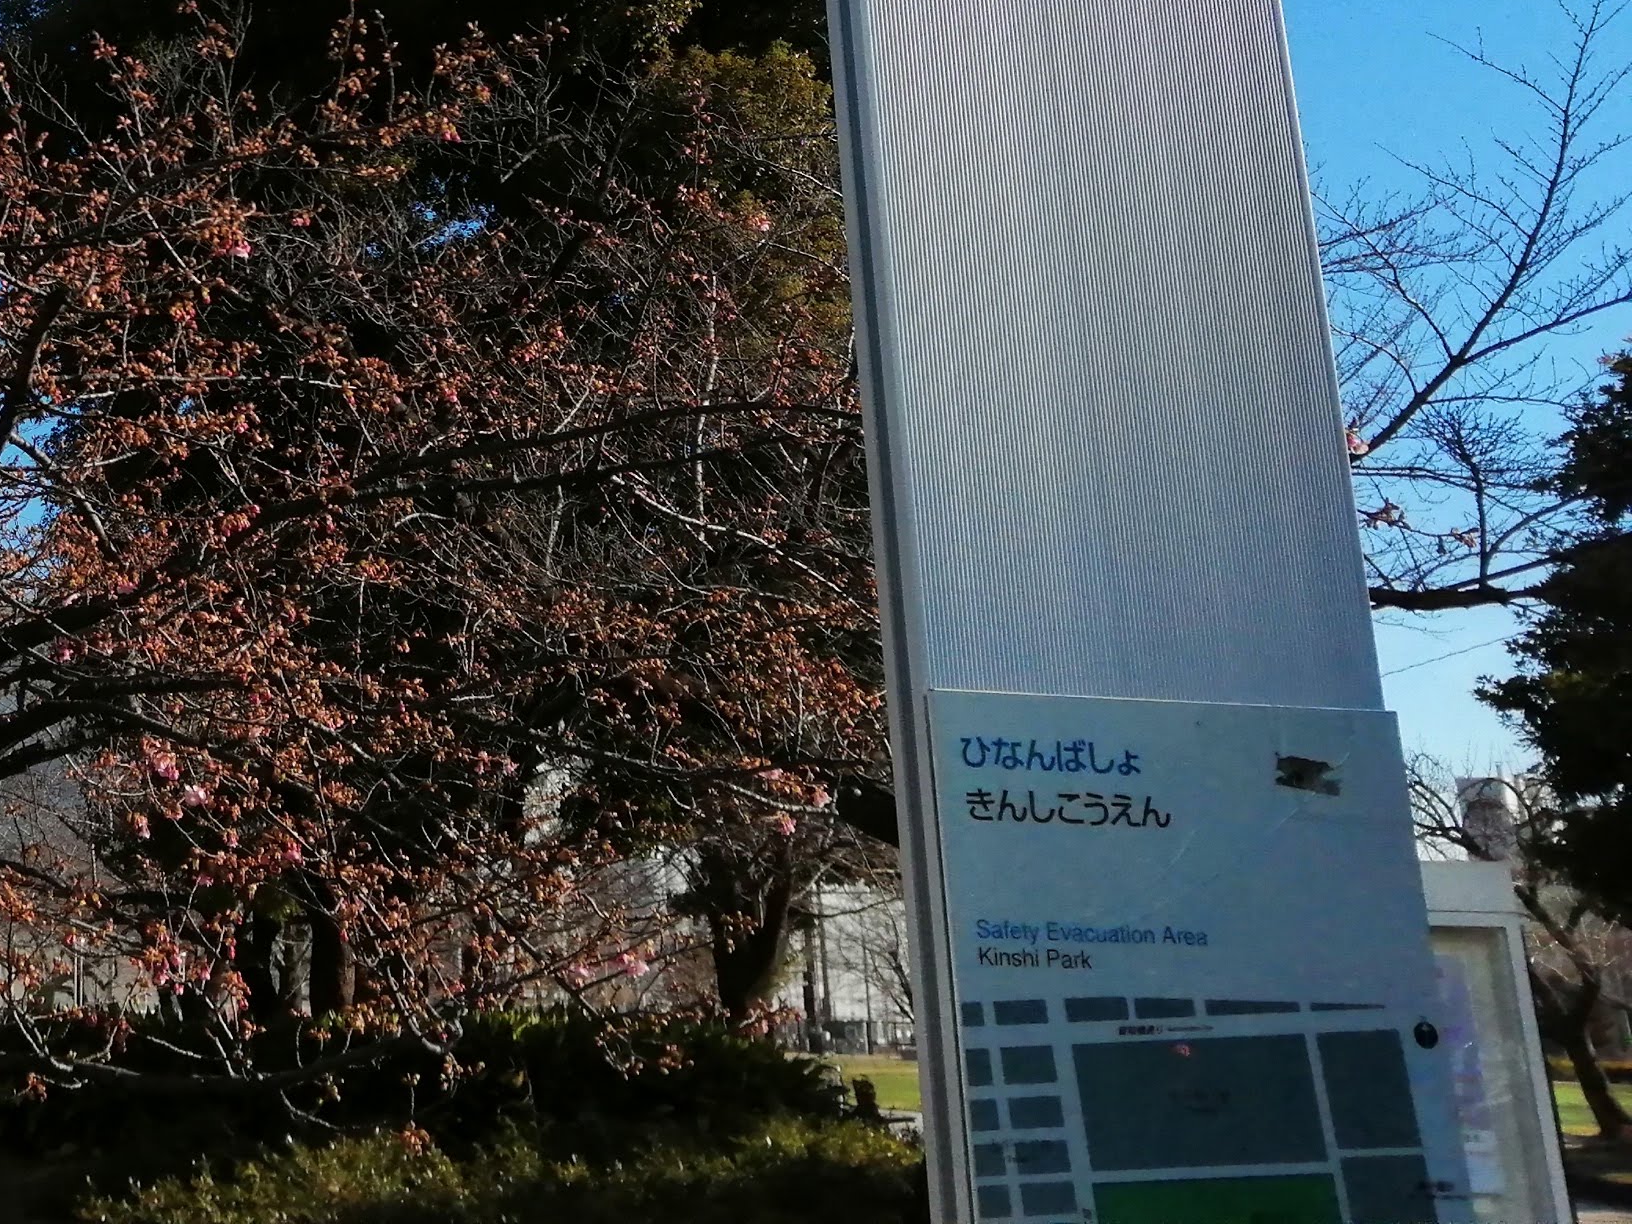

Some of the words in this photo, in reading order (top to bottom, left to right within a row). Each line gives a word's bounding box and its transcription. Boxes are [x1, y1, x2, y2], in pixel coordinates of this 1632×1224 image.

[959, 735, 1142, 777] ひなんばしょ
[965, 787, 1172, 828] きんしこうえん
[975, 918, 1040, 946] Safety
[1045, 921, 1157, 945] Evacuation
[1162, 925, 1210, 947] Area
[977, 946, 1041, 968] Kinshi
[1045, 947, 1093, 970] Park
